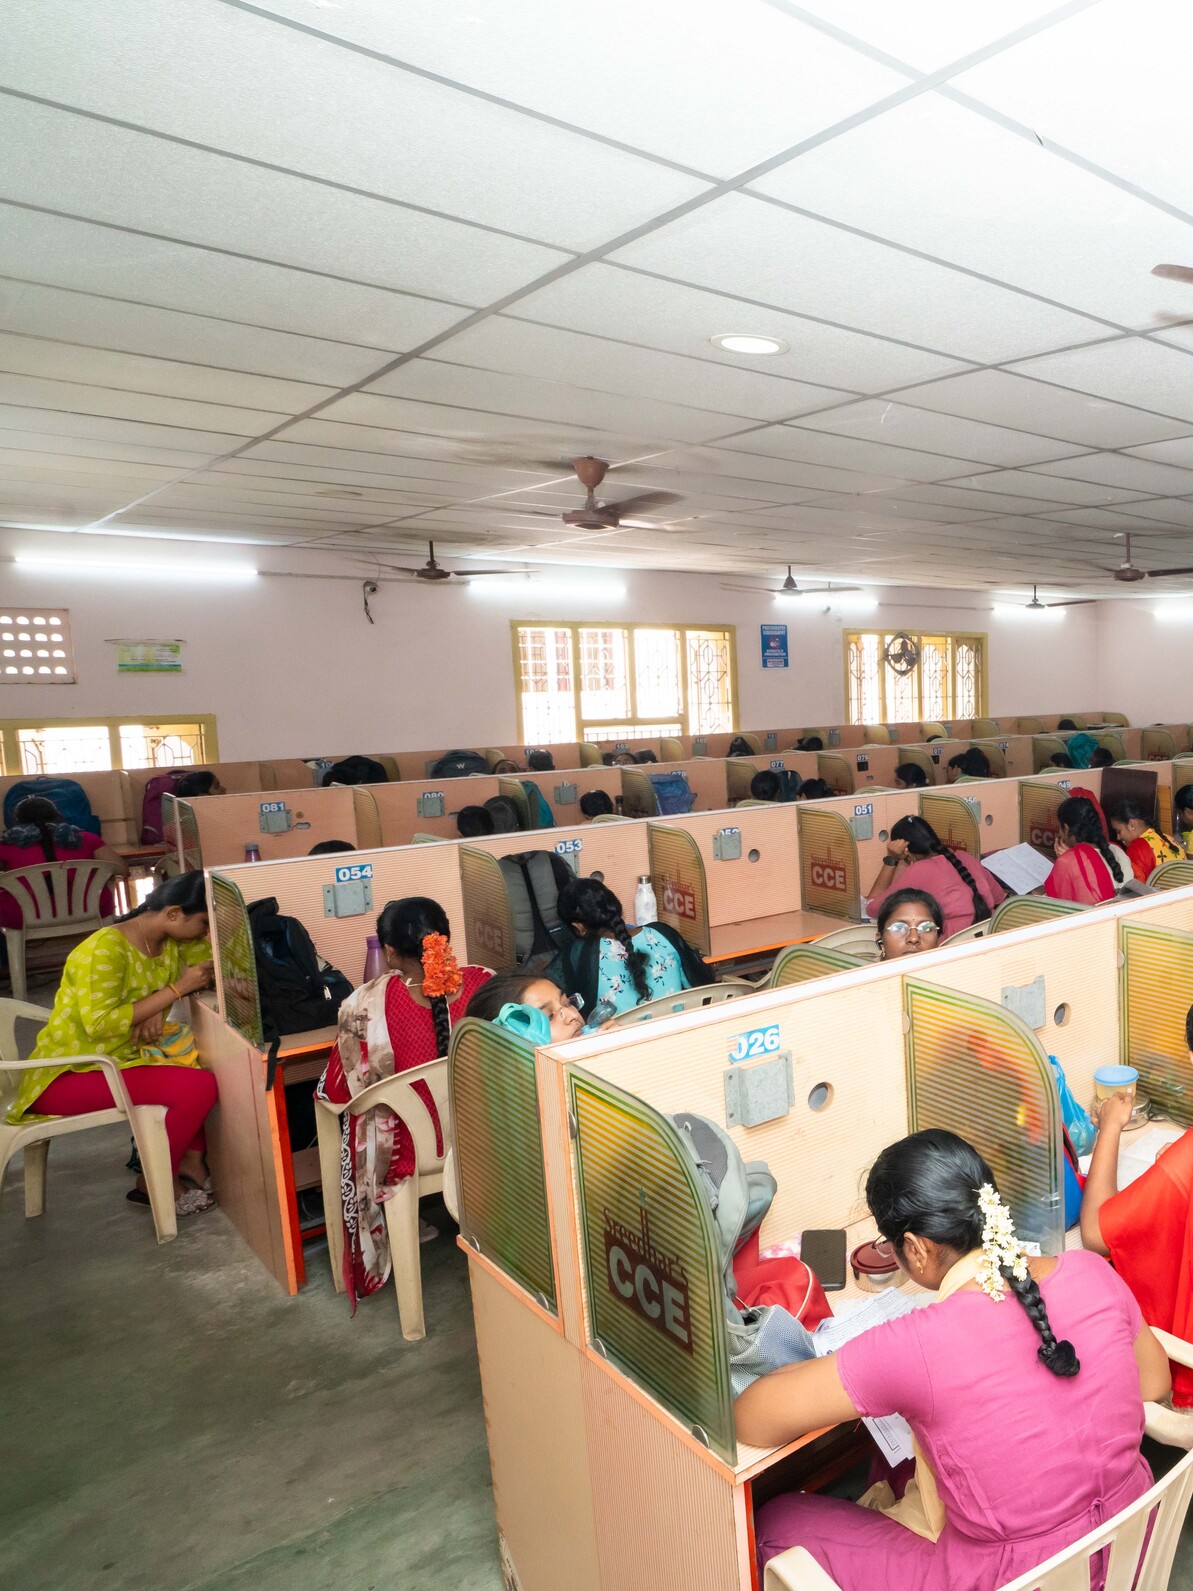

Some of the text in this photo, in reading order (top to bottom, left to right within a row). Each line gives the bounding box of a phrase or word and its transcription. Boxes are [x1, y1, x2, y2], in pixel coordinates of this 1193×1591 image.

[262, 802, 285, 812] 081
[857, 805, 873, 816] 051
[556, 840, 583, 854] 053
[338, 865, 373, 881] 054
[812, 866, 846, 889] CCE
[663, 890, 695, 917] CCE
[603, 1207, 688, 1286] Sreedhar's
[609, 1245, 689, 1344] CCE
